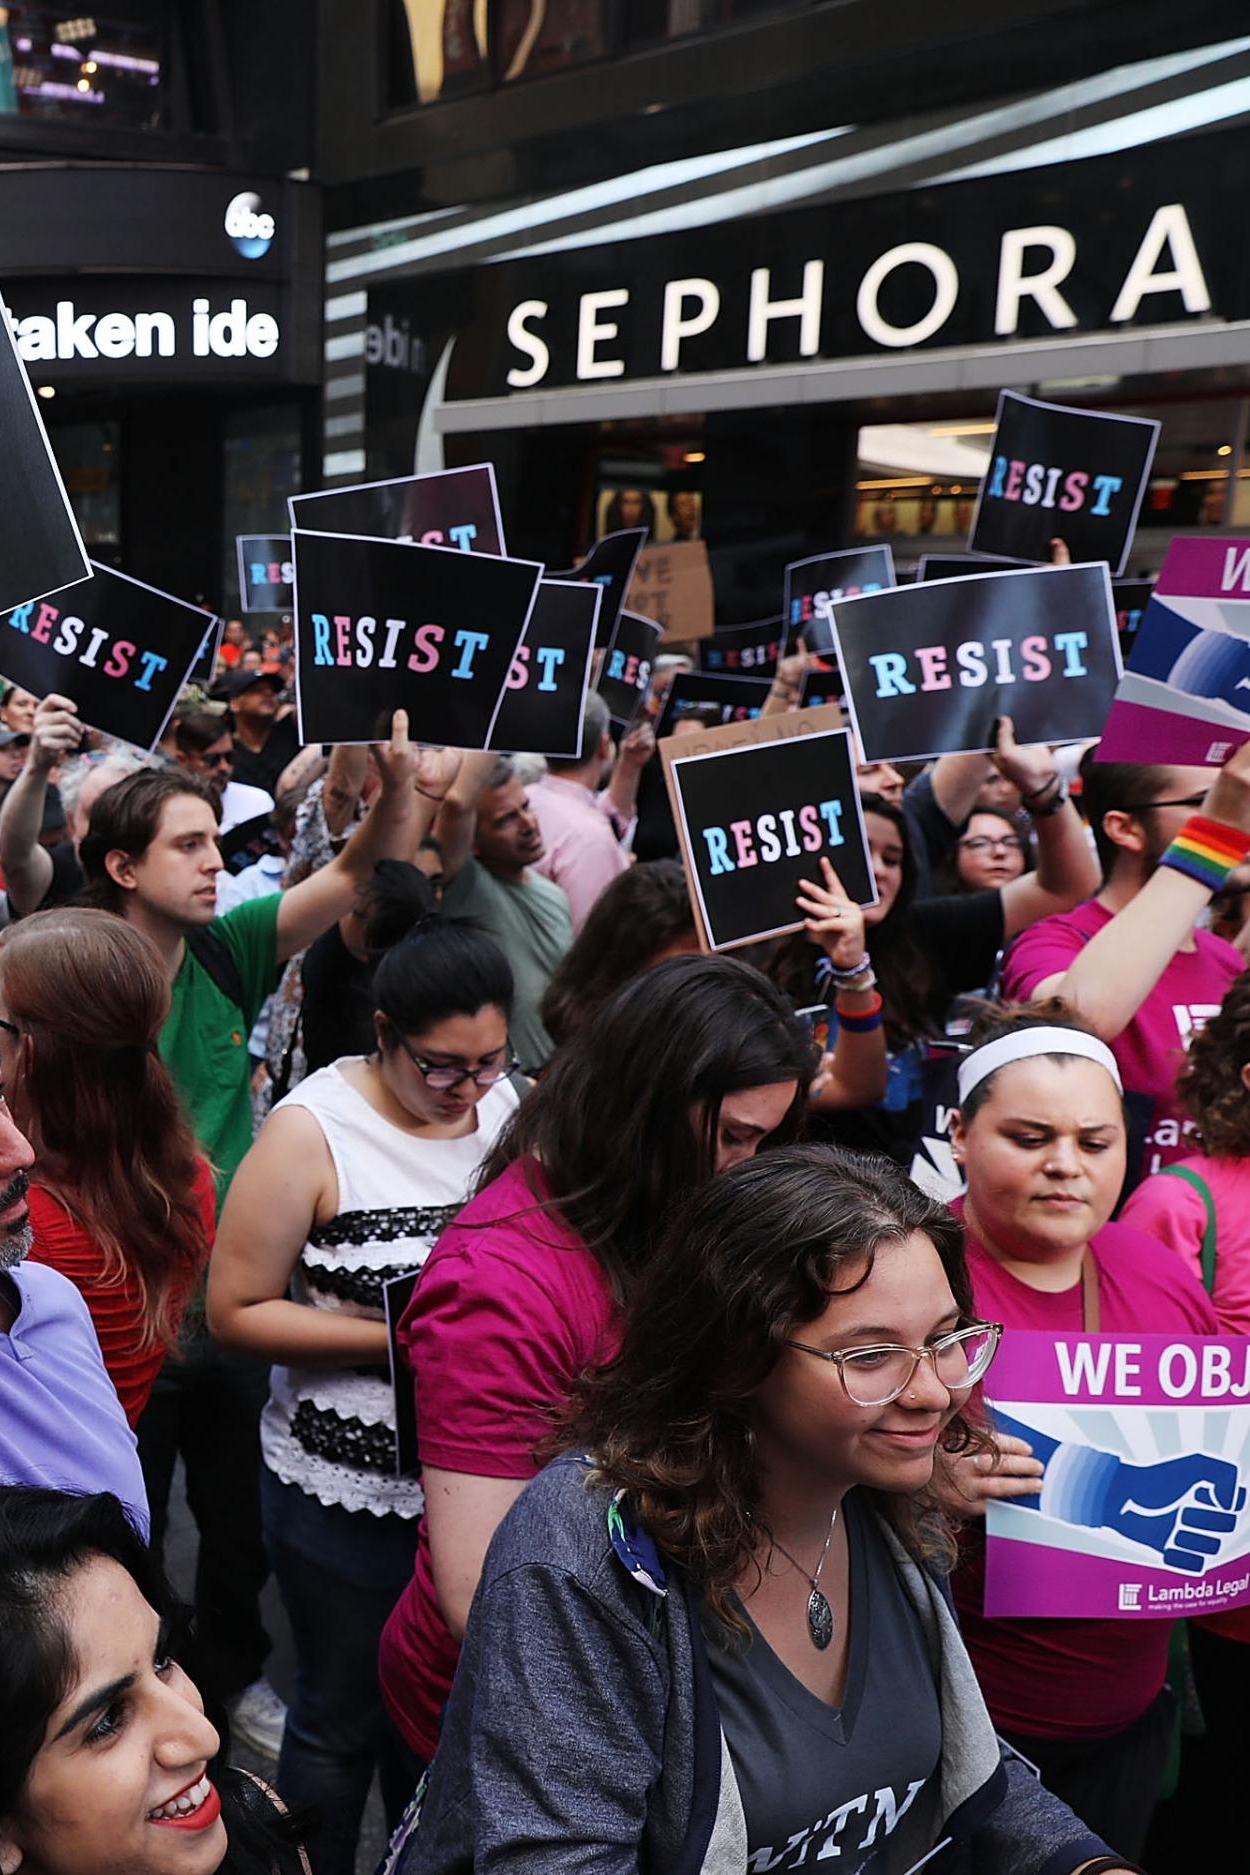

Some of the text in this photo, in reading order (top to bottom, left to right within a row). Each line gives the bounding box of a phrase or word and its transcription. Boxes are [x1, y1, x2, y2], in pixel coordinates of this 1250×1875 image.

[506, 203, 1211, 388] SEPHORA
[2, 299, 279, 361] aken ide
[988, 455, 1122, 516] RESIST
[7, 600, 168, 692] RESIST
[311, 613, 490, 680] RESIST
[869, 631, 1088, 698] RESIST
[702, 799, 844, 876] RESIST
[1054, 1341, 1250, 1399] WE OBJ
[1148, 1573, 1250, 1601] Lambda Legal
